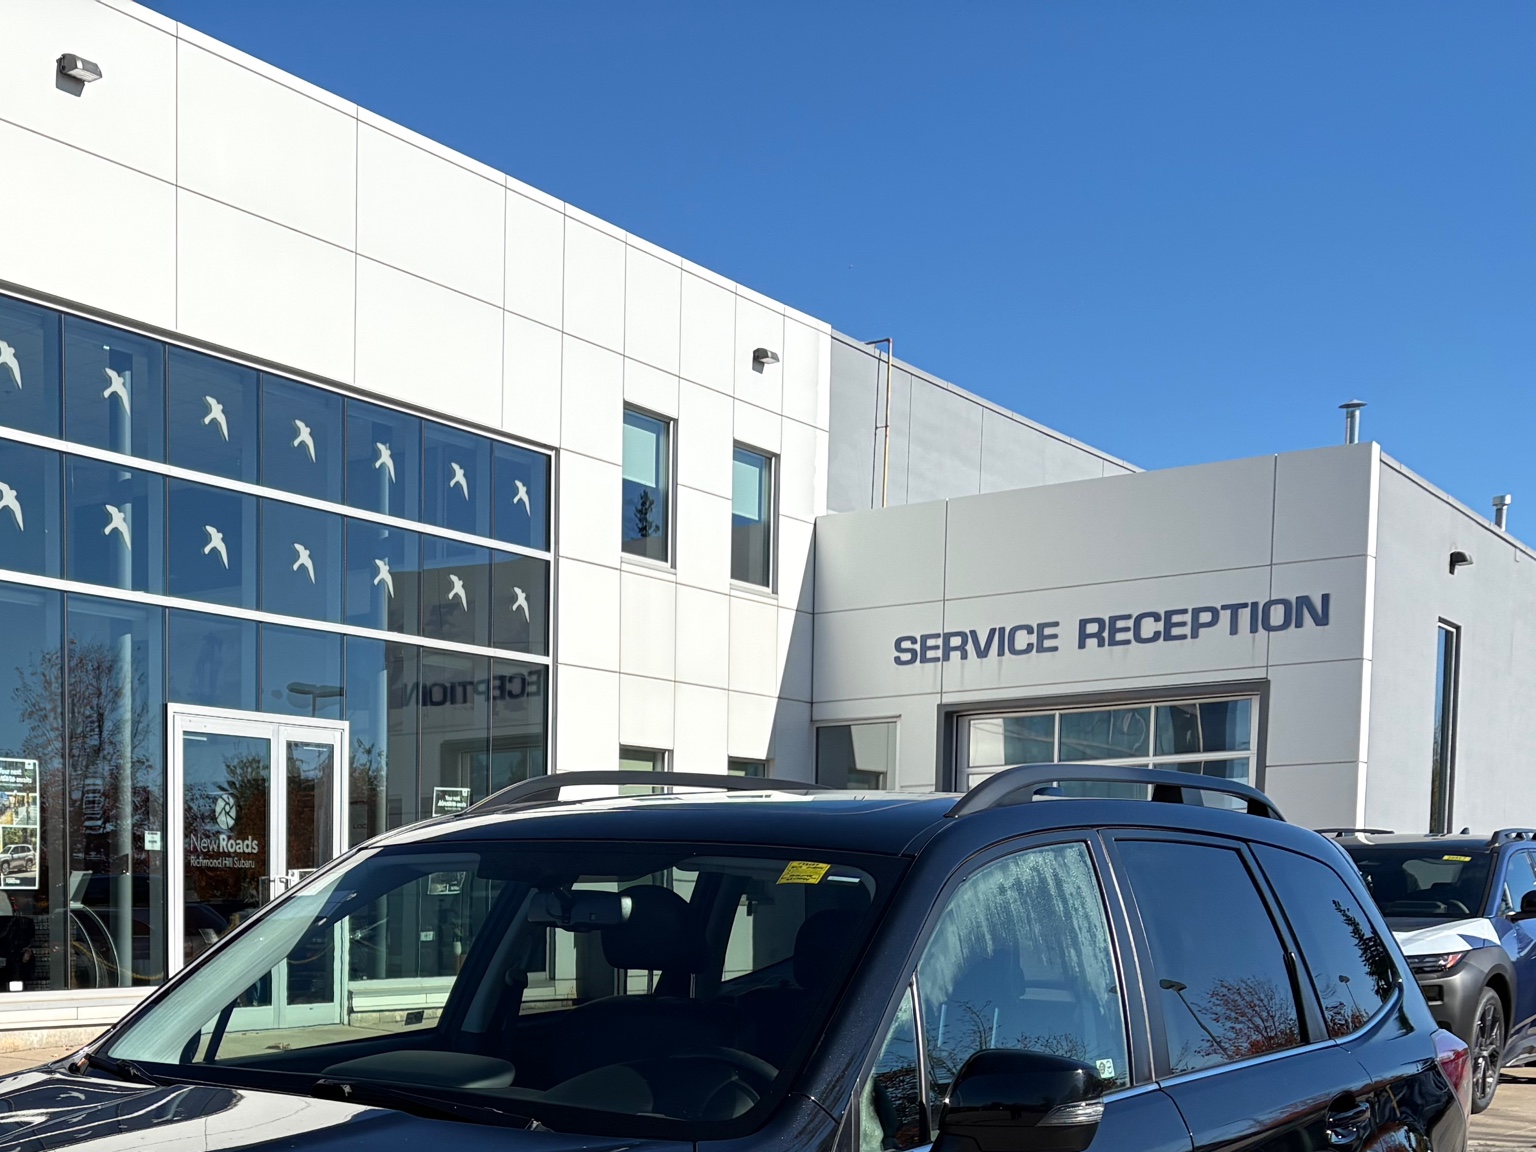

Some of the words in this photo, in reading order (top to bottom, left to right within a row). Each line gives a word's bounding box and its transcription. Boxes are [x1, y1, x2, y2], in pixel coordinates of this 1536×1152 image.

[893, 621, 1060, 666] SERVICE
[1077, 593, 1331, 650] RECEPTION
[191, 855, 221, 867] Richmond
[222, 857, 233, 867] Hill
[234, 857, 254, 868] Subaru
